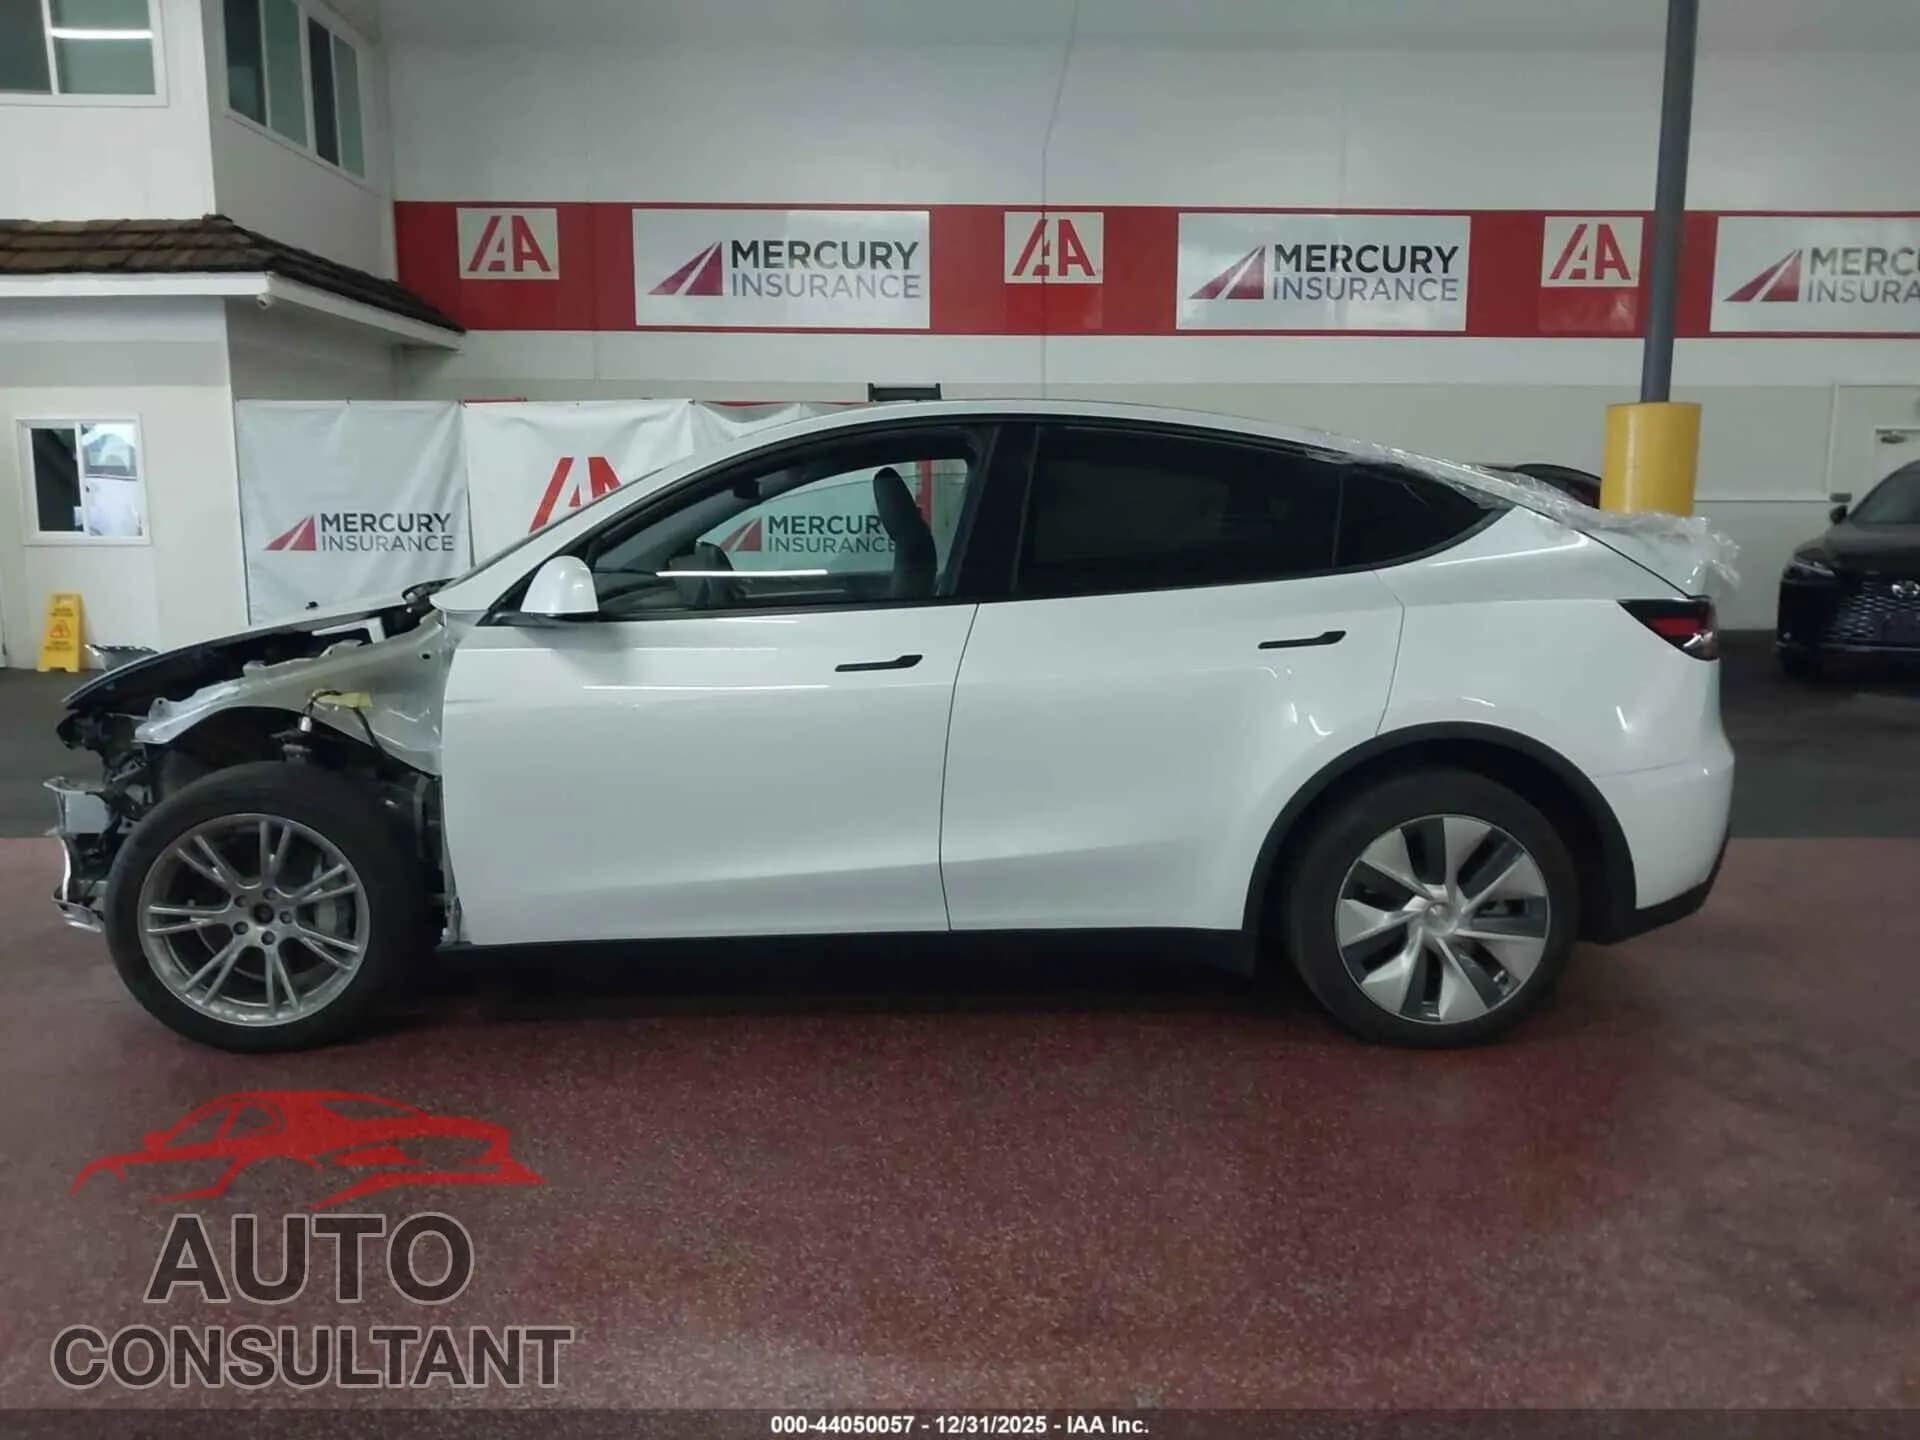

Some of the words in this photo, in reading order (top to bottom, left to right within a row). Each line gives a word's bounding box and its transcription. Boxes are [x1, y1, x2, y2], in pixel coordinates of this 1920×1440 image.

[731, 240, 919, 270] MERCURY
[1273, 244, 1459, 274] MERCURY
[1809, 246, 1920, 276] MERC
[731, 272, 921, 299] INSURANCE
[1272, 276, 1459, 302] INSURANCE
[320, 513, 451, 533] MERCURY
[768, 515, 884, 535] MERCUR
[321, 535, 455, 552] INSURANCE
